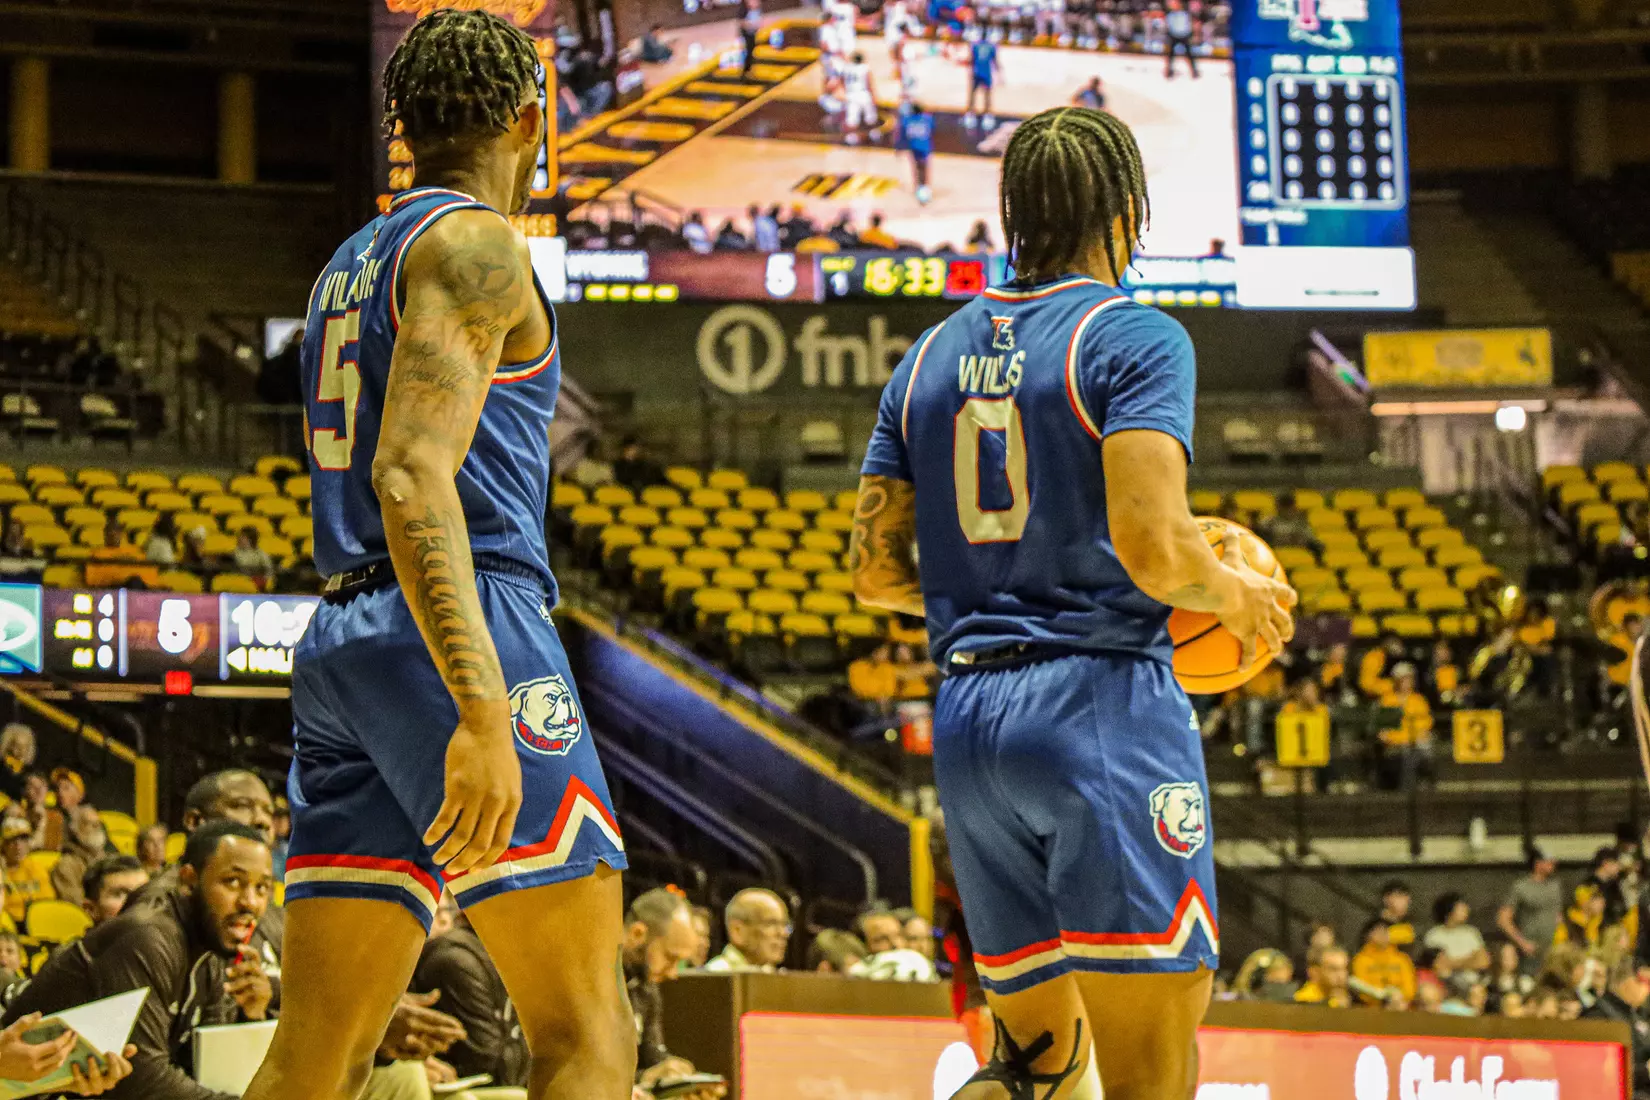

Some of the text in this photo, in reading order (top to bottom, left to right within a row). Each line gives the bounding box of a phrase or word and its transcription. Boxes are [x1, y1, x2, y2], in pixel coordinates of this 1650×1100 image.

[312, 307, 361, 471] 5
[953, 396, 1030, 544] 0
[1295, 720, 1308, 759] 1
[1468, 718, 1488, 754] 3
